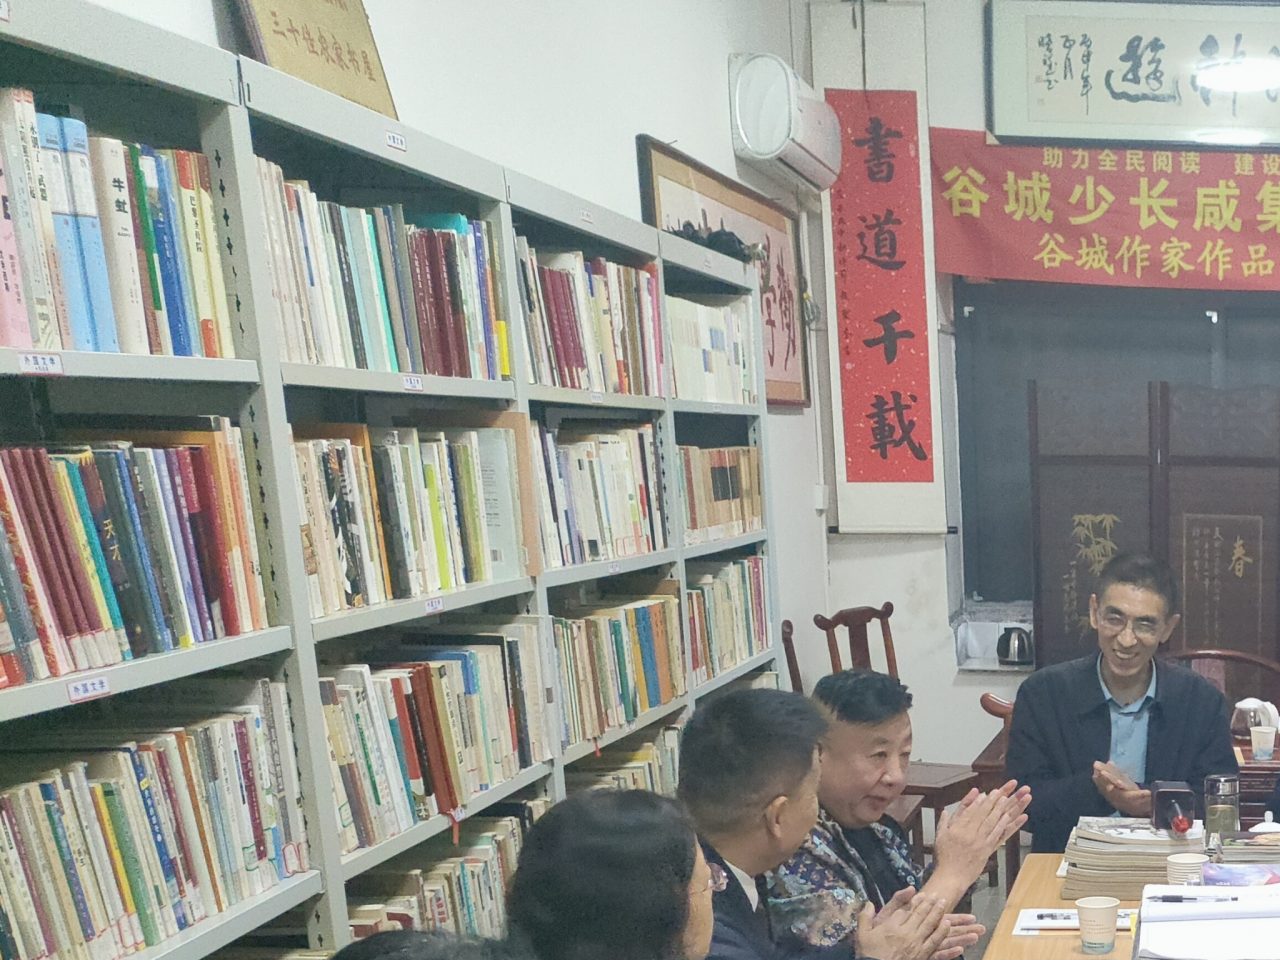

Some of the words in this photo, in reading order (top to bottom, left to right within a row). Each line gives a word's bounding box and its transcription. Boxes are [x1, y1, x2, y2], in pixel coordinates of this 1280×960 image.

[1042, 147, 1201, 175] 助力全民阅读
